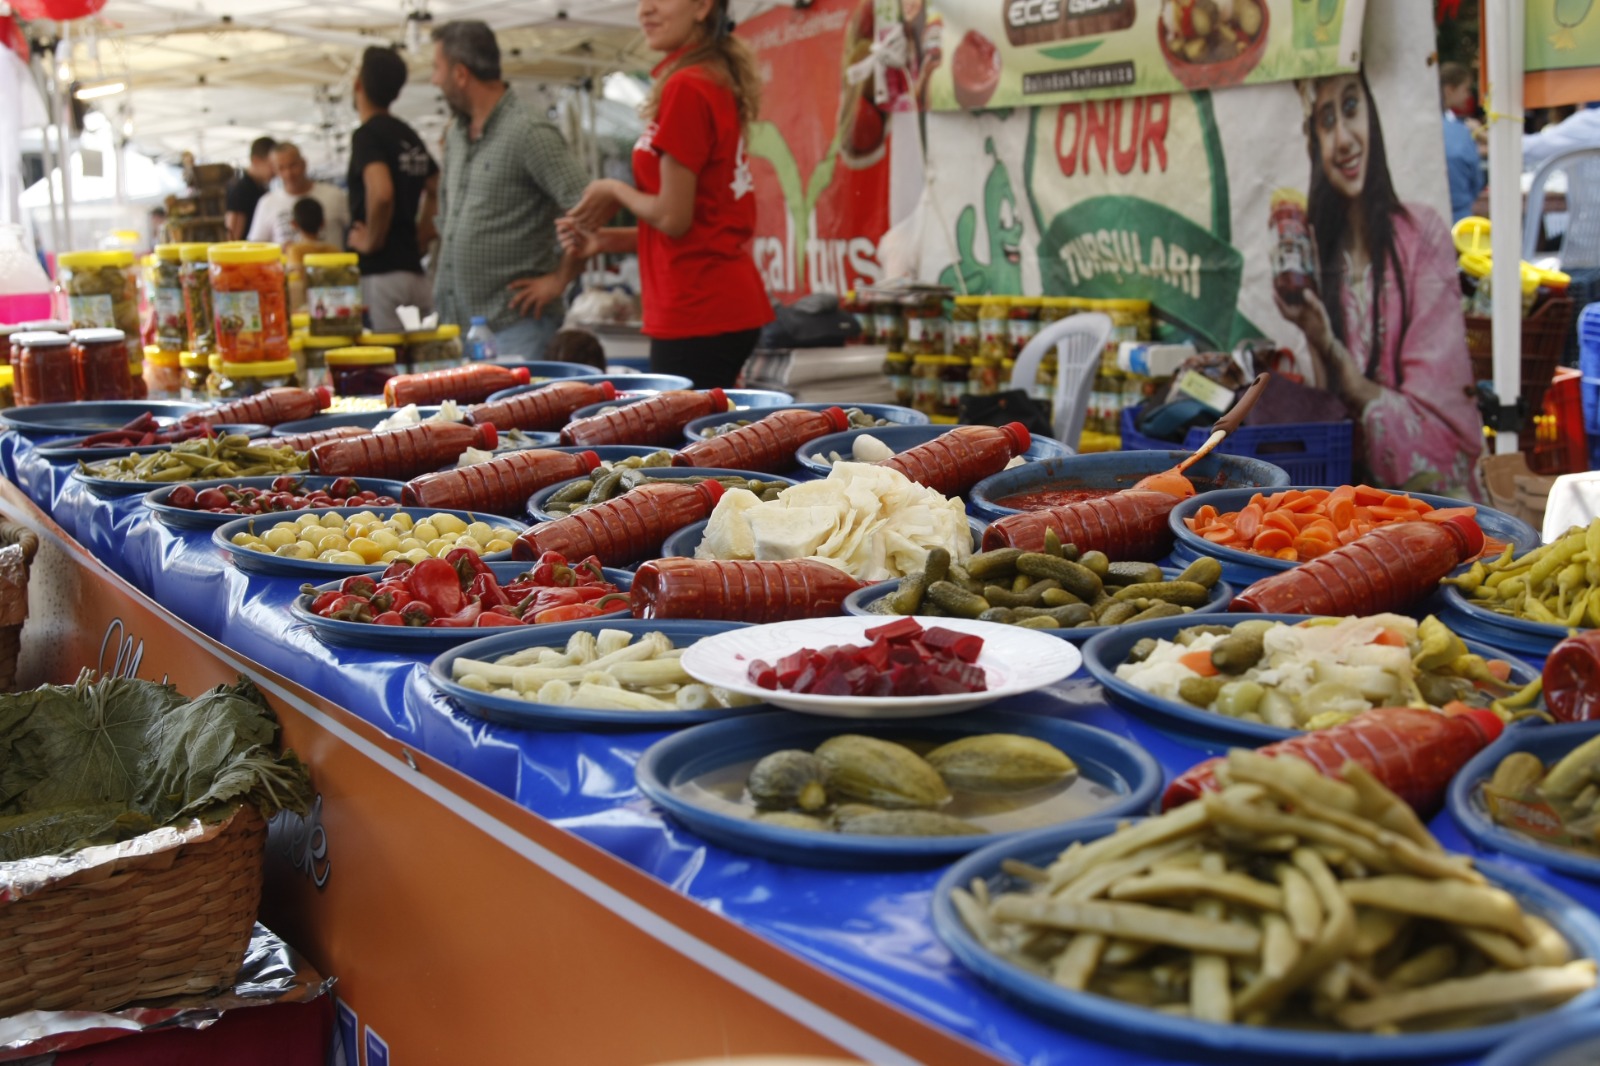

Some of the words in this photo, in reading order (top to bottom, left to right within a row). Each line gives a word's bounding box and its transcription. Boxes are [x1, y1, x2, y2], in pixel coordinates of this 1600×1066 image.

[1008, 0, 1060, 27] ECE
[1055, 94, 1171, 177] ONUR
[1059, 229, 1201, 299] TURŞULARI
